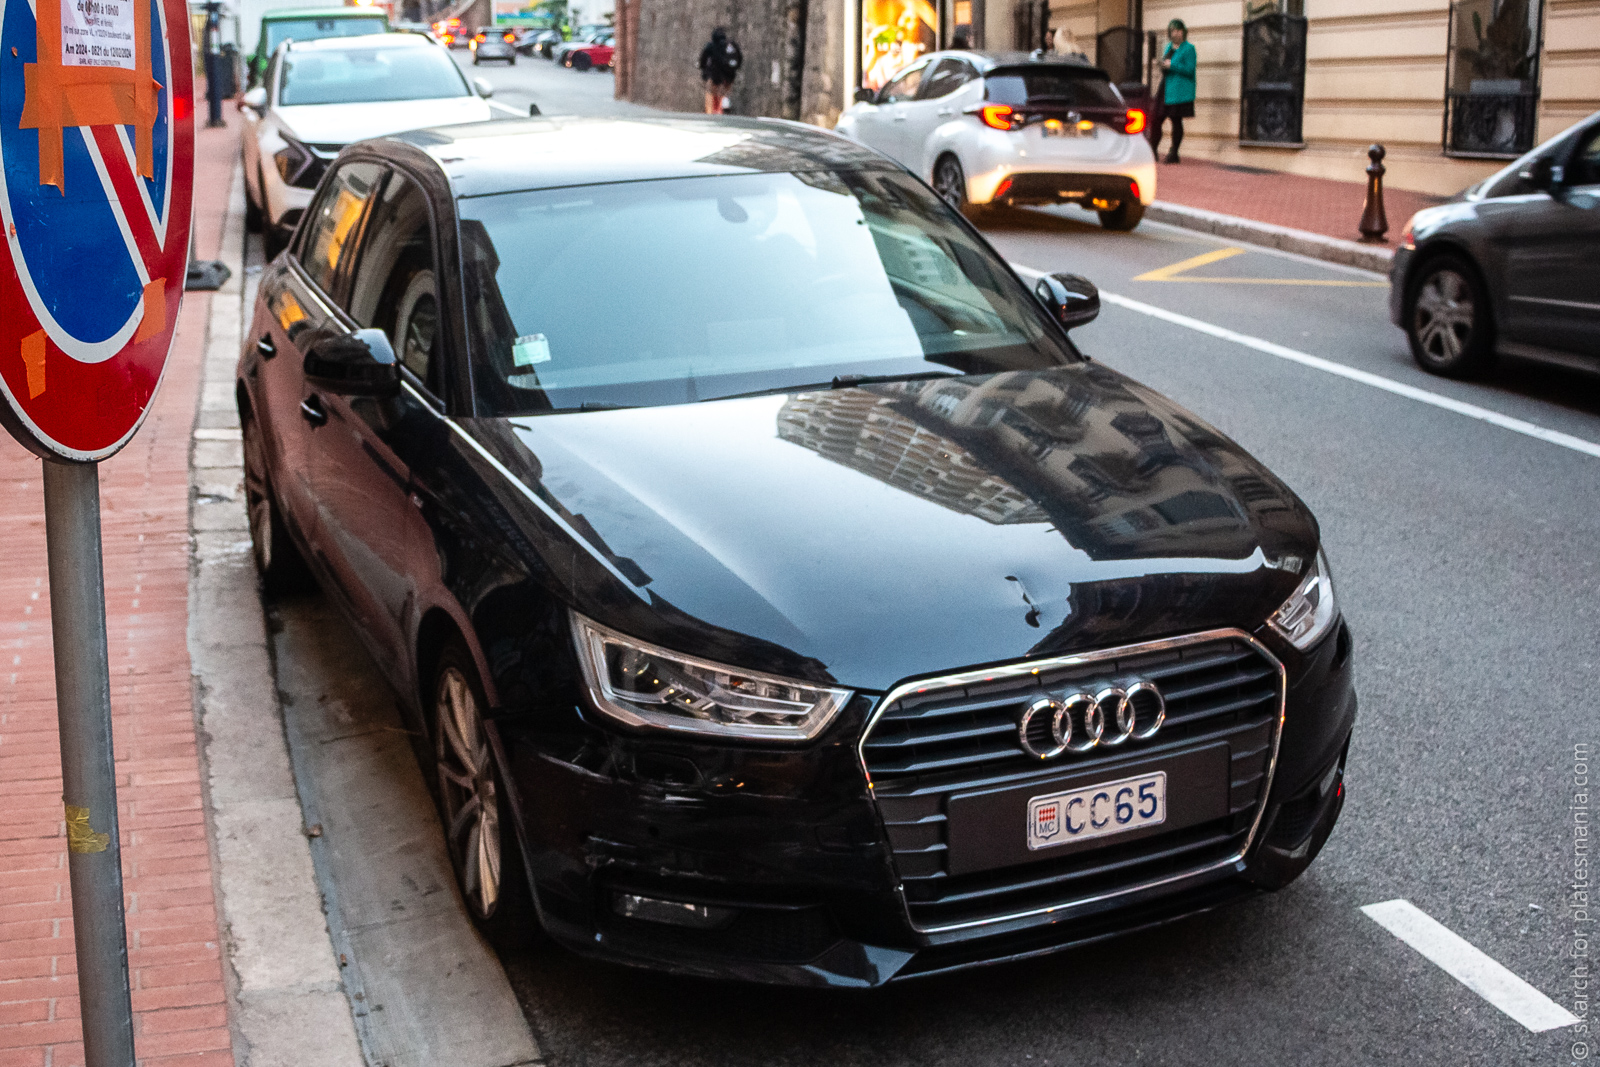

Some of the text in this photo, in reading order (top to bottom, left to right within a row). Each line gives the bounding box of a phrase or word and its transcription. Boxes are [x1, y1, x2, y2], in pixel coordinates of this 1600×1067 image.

[77, 0, 84, 11] de
[65, 43, 74, 54] Am
[76, 44, 87, 55] 2024
[103, 46, 109, 56] du
[1040, 782, 1158, 834] MC CC65
